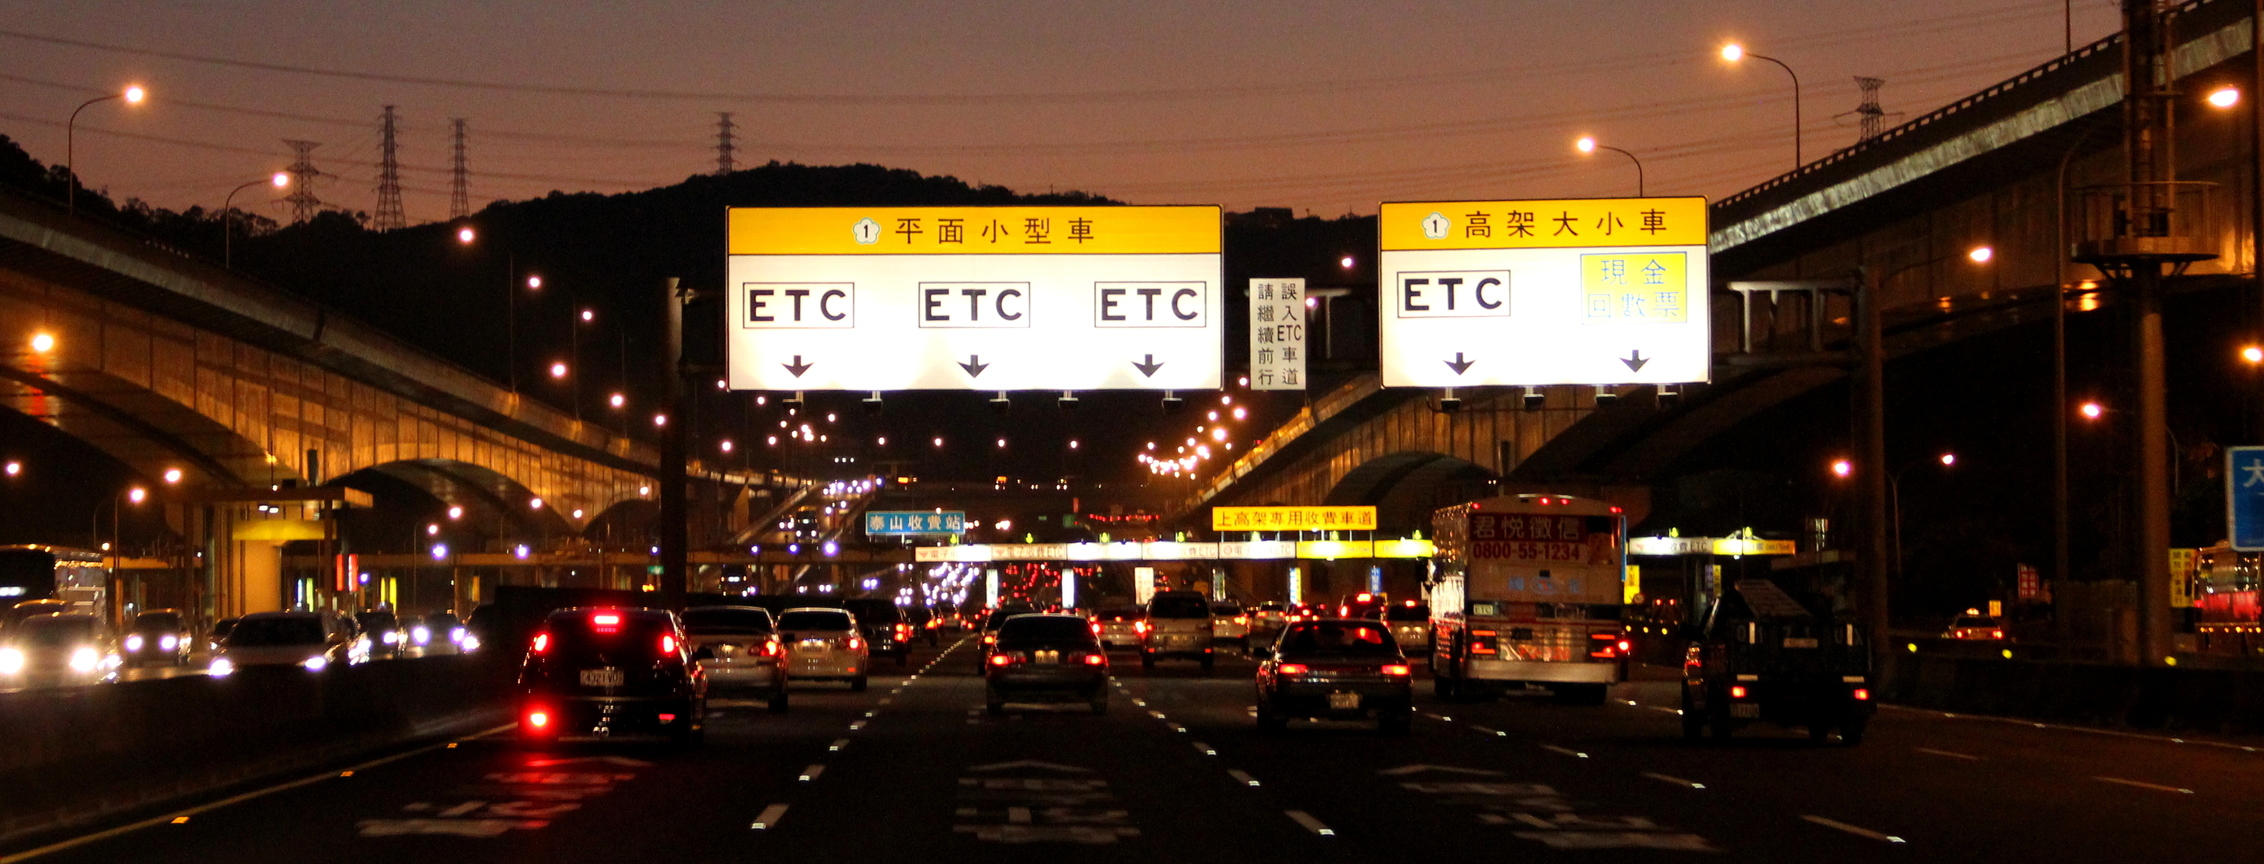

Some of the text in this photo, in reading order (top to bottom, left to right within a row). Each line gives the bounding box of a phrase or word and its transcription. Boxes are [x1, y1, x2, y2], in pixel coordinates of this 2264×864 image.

[895, 217, 1096, 245] 平面小型車
[1465, 208, 1668, 239] 高架大小車
[1600, 258, 1667, 285] 現金
[749, 289, 848, 322] ETC
[925, 289, 1023, 322] ETC
[1101, 288, 1200, 321] ETC
[1404, 278, 1502, 312] ETC
[1587, 291, 1680, 318] 回數票
[1257, 282, 1274, 386] 請繼續前行
[869, 514, 961, 531] 泰山收費站
[1217, 510, 1373, 527] 上高架專用收費車道
[1473, 515, 1580, 540] 君悅徵信
[1473, 542, 1580, 561] 0800-55-1234
